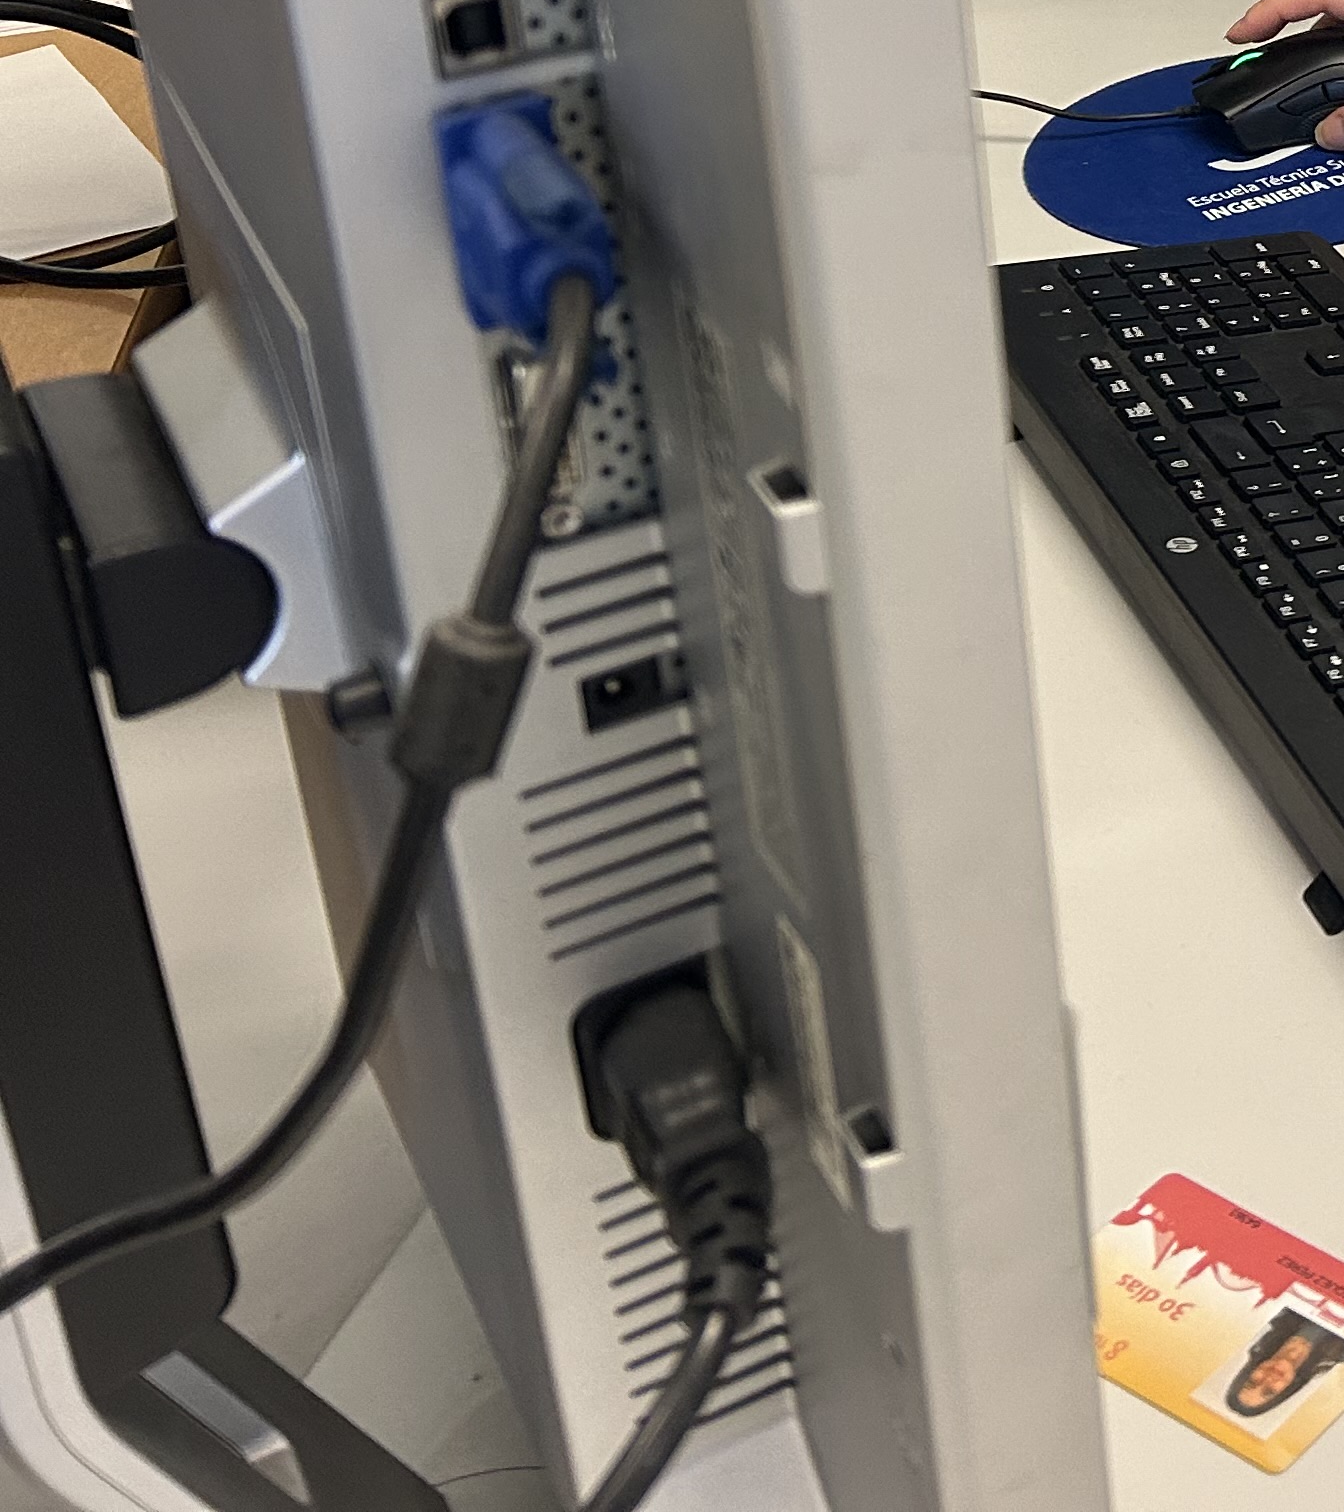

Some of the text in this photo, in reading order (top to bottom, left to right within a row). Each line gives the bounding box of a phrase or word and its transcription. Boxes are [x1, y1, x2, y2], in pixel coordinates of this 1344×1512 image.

[1187, 180, 1262, 209] Escuela
[1255, 164, 1328, 191] Técnica
[1201, 179, 1331, 221] INGENIERÍA
[1158, 1298, 1196, 1322] 30
